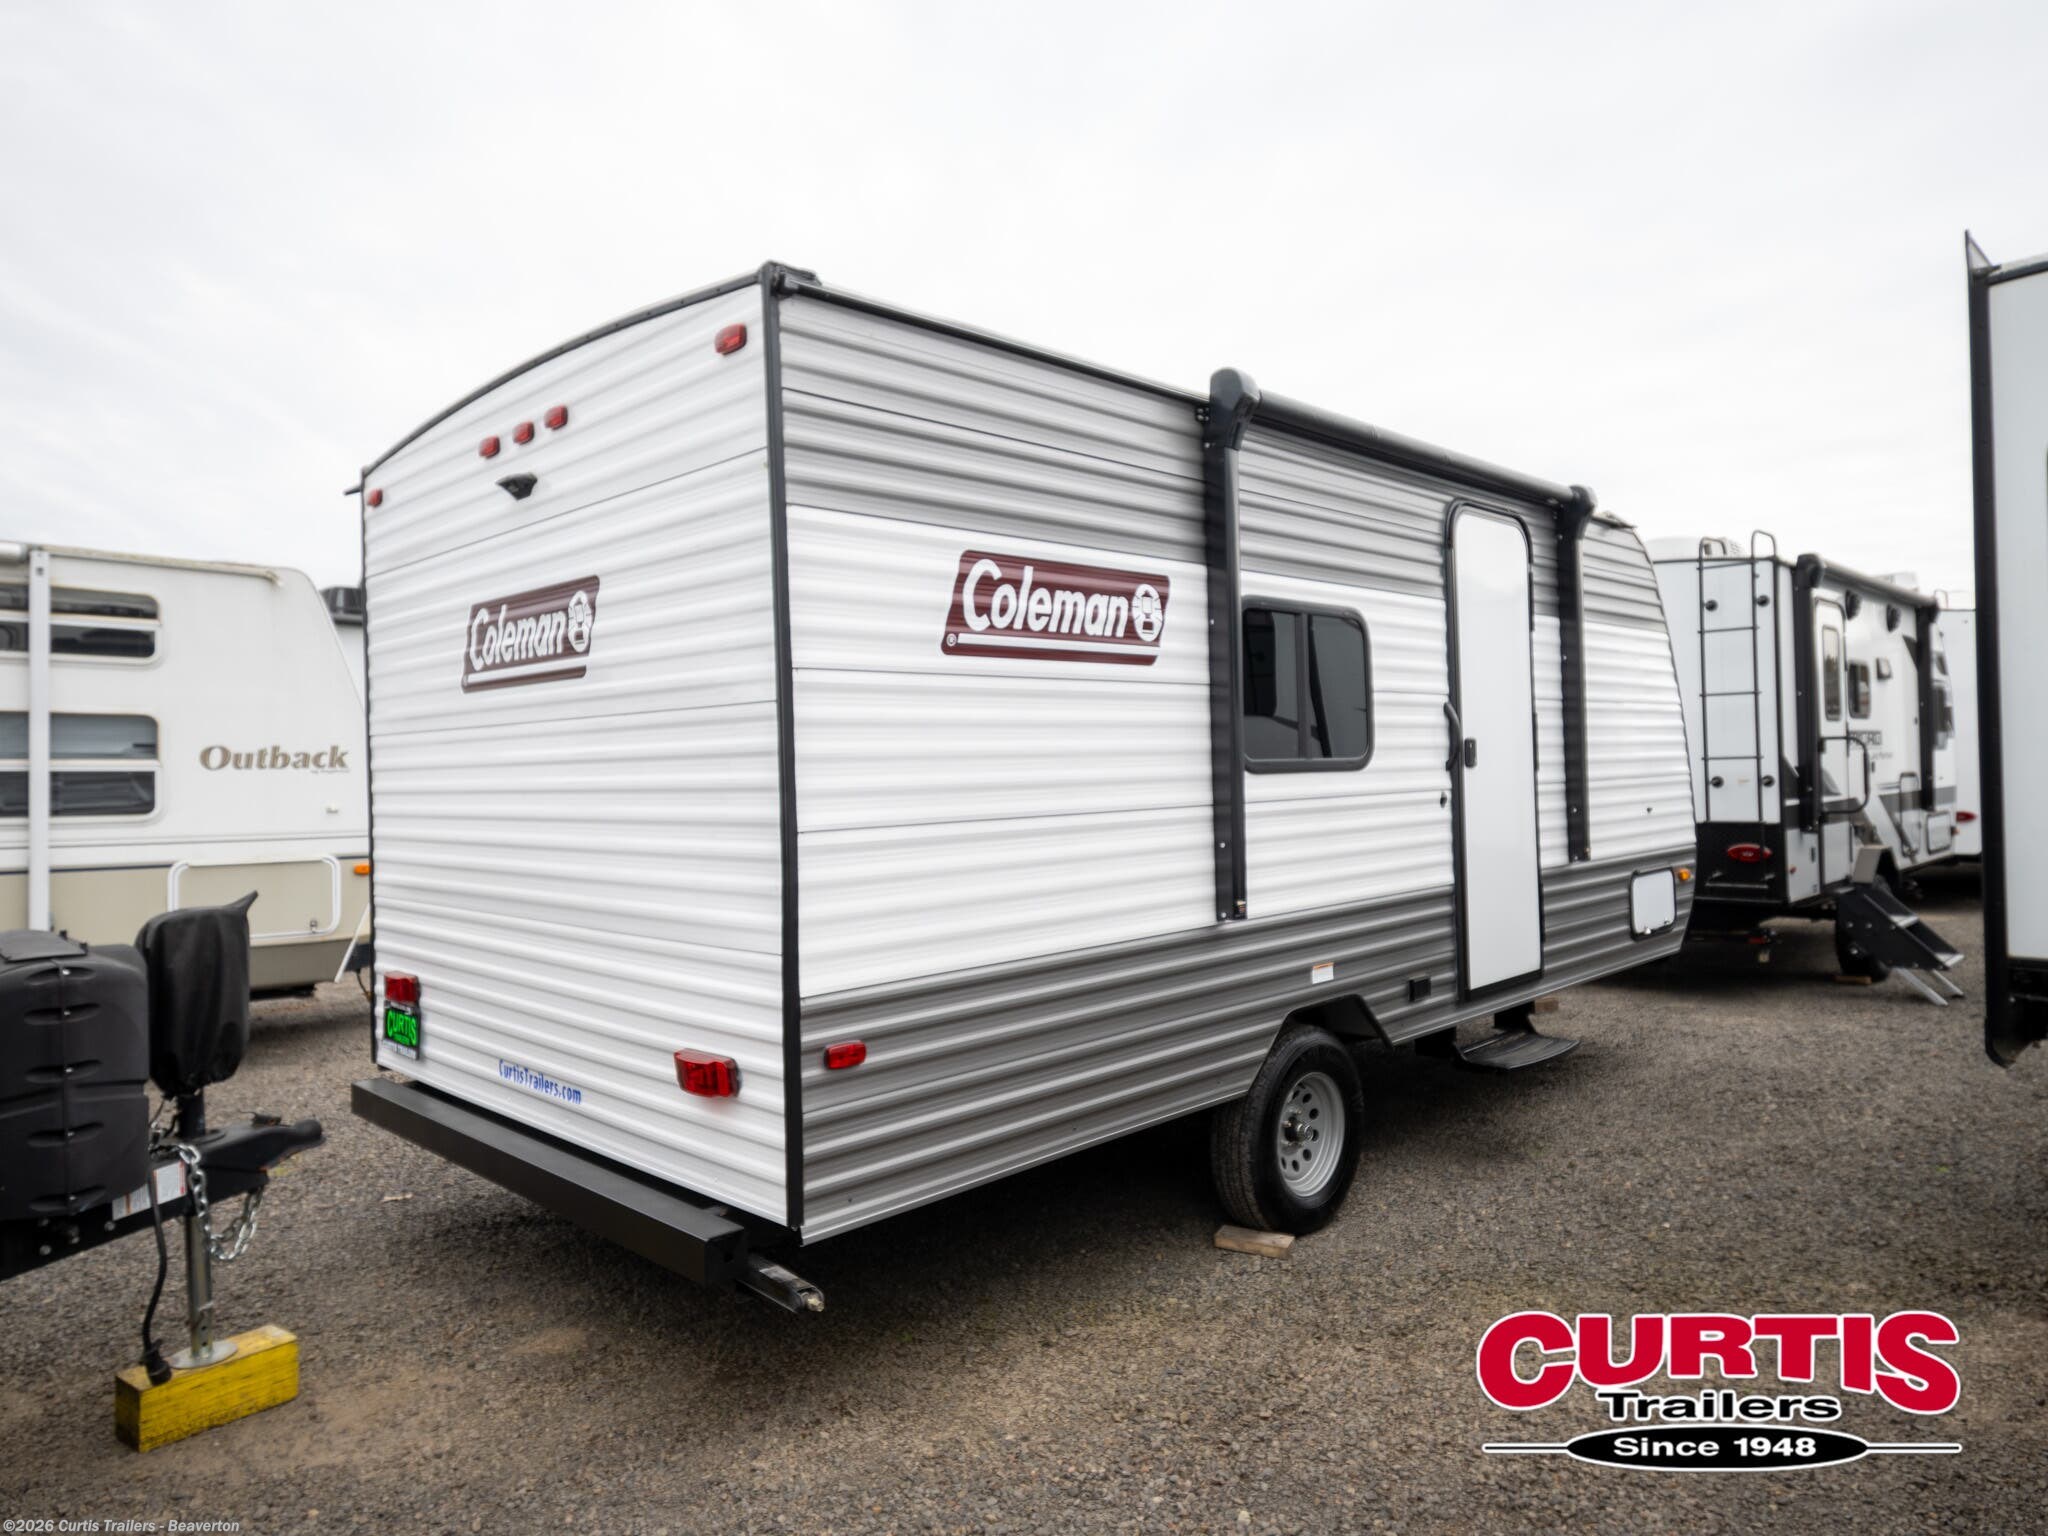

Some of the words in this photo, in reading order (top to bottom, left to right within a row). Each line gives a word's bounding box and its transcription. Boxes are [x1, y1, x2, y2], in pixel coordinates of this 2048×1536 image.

[962, 558, 1129, 638] Coleman
[469, 604, 567, 671] Coleman
[199, 745, 349, 771] Outback
[498, 1059, 582, 1105] CurtisTrailers.com
